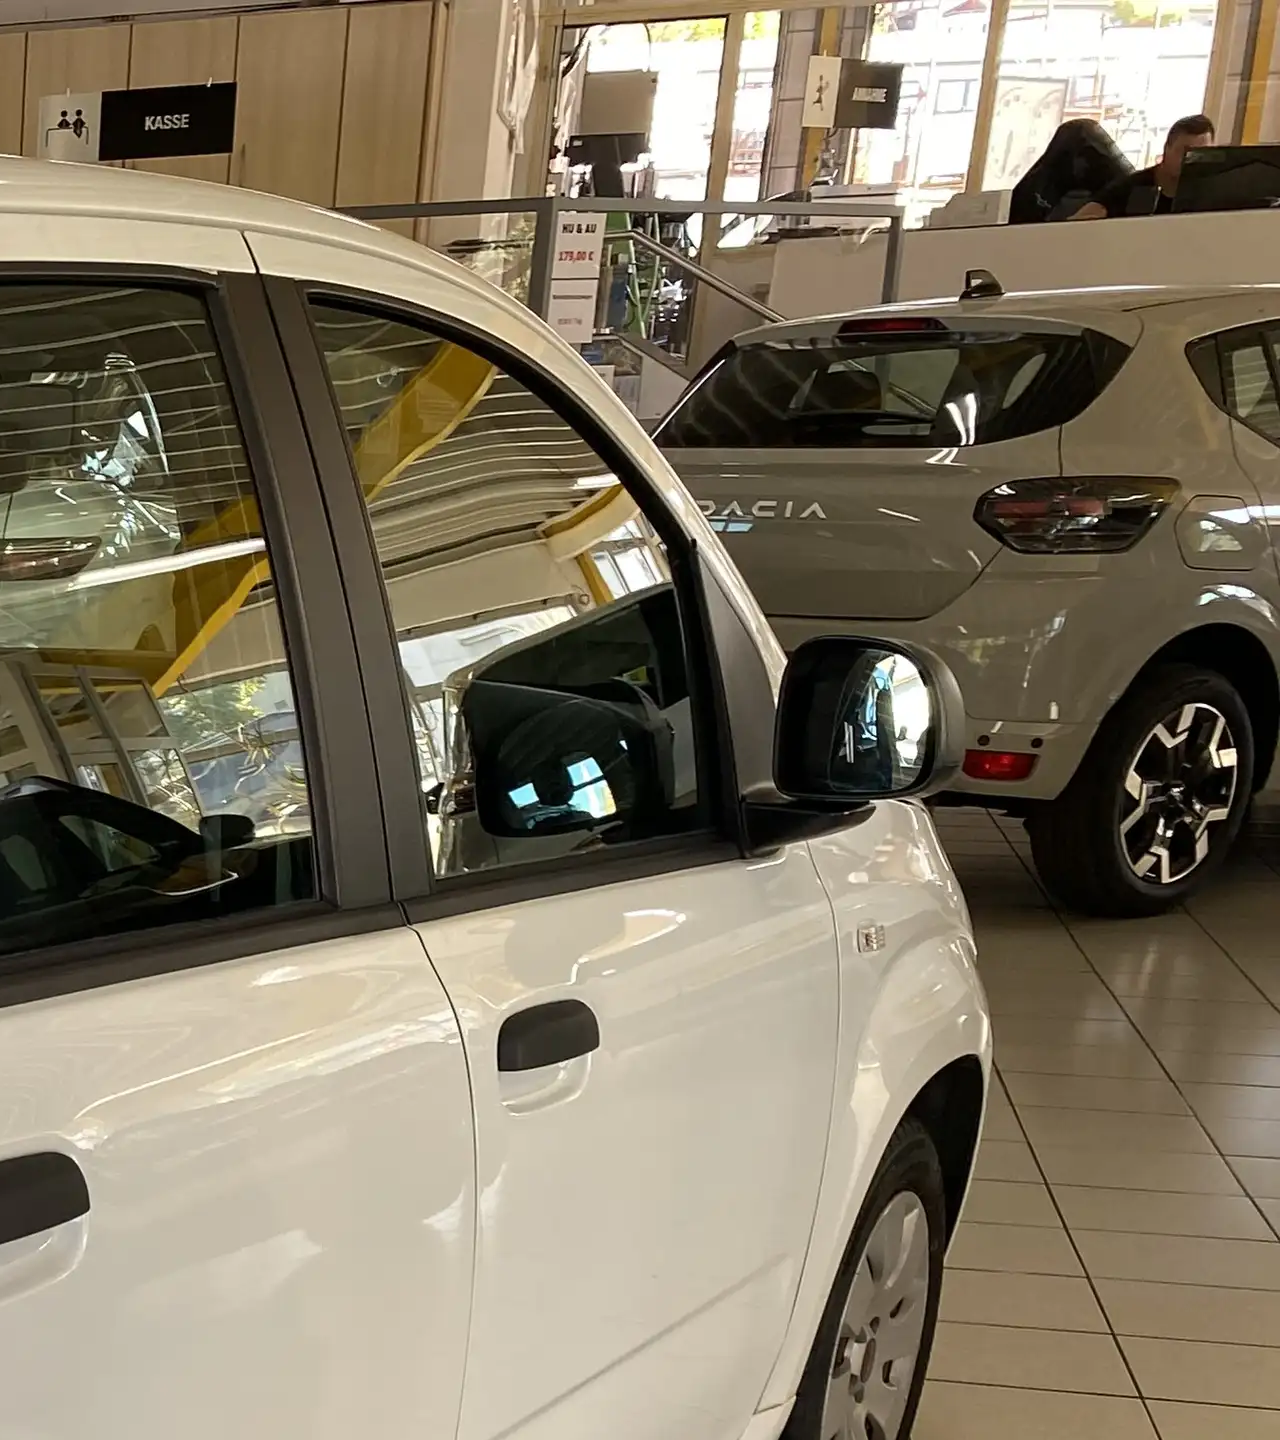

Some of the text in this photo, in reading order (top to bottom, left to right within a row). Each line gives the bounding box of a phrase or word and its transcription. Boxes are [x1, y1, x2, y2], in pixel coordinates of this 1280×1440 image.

[145, 114, 190, 130] KASSE
[584, 224, 597, 233] AU
[696, 500, 827, 519] DACIA
